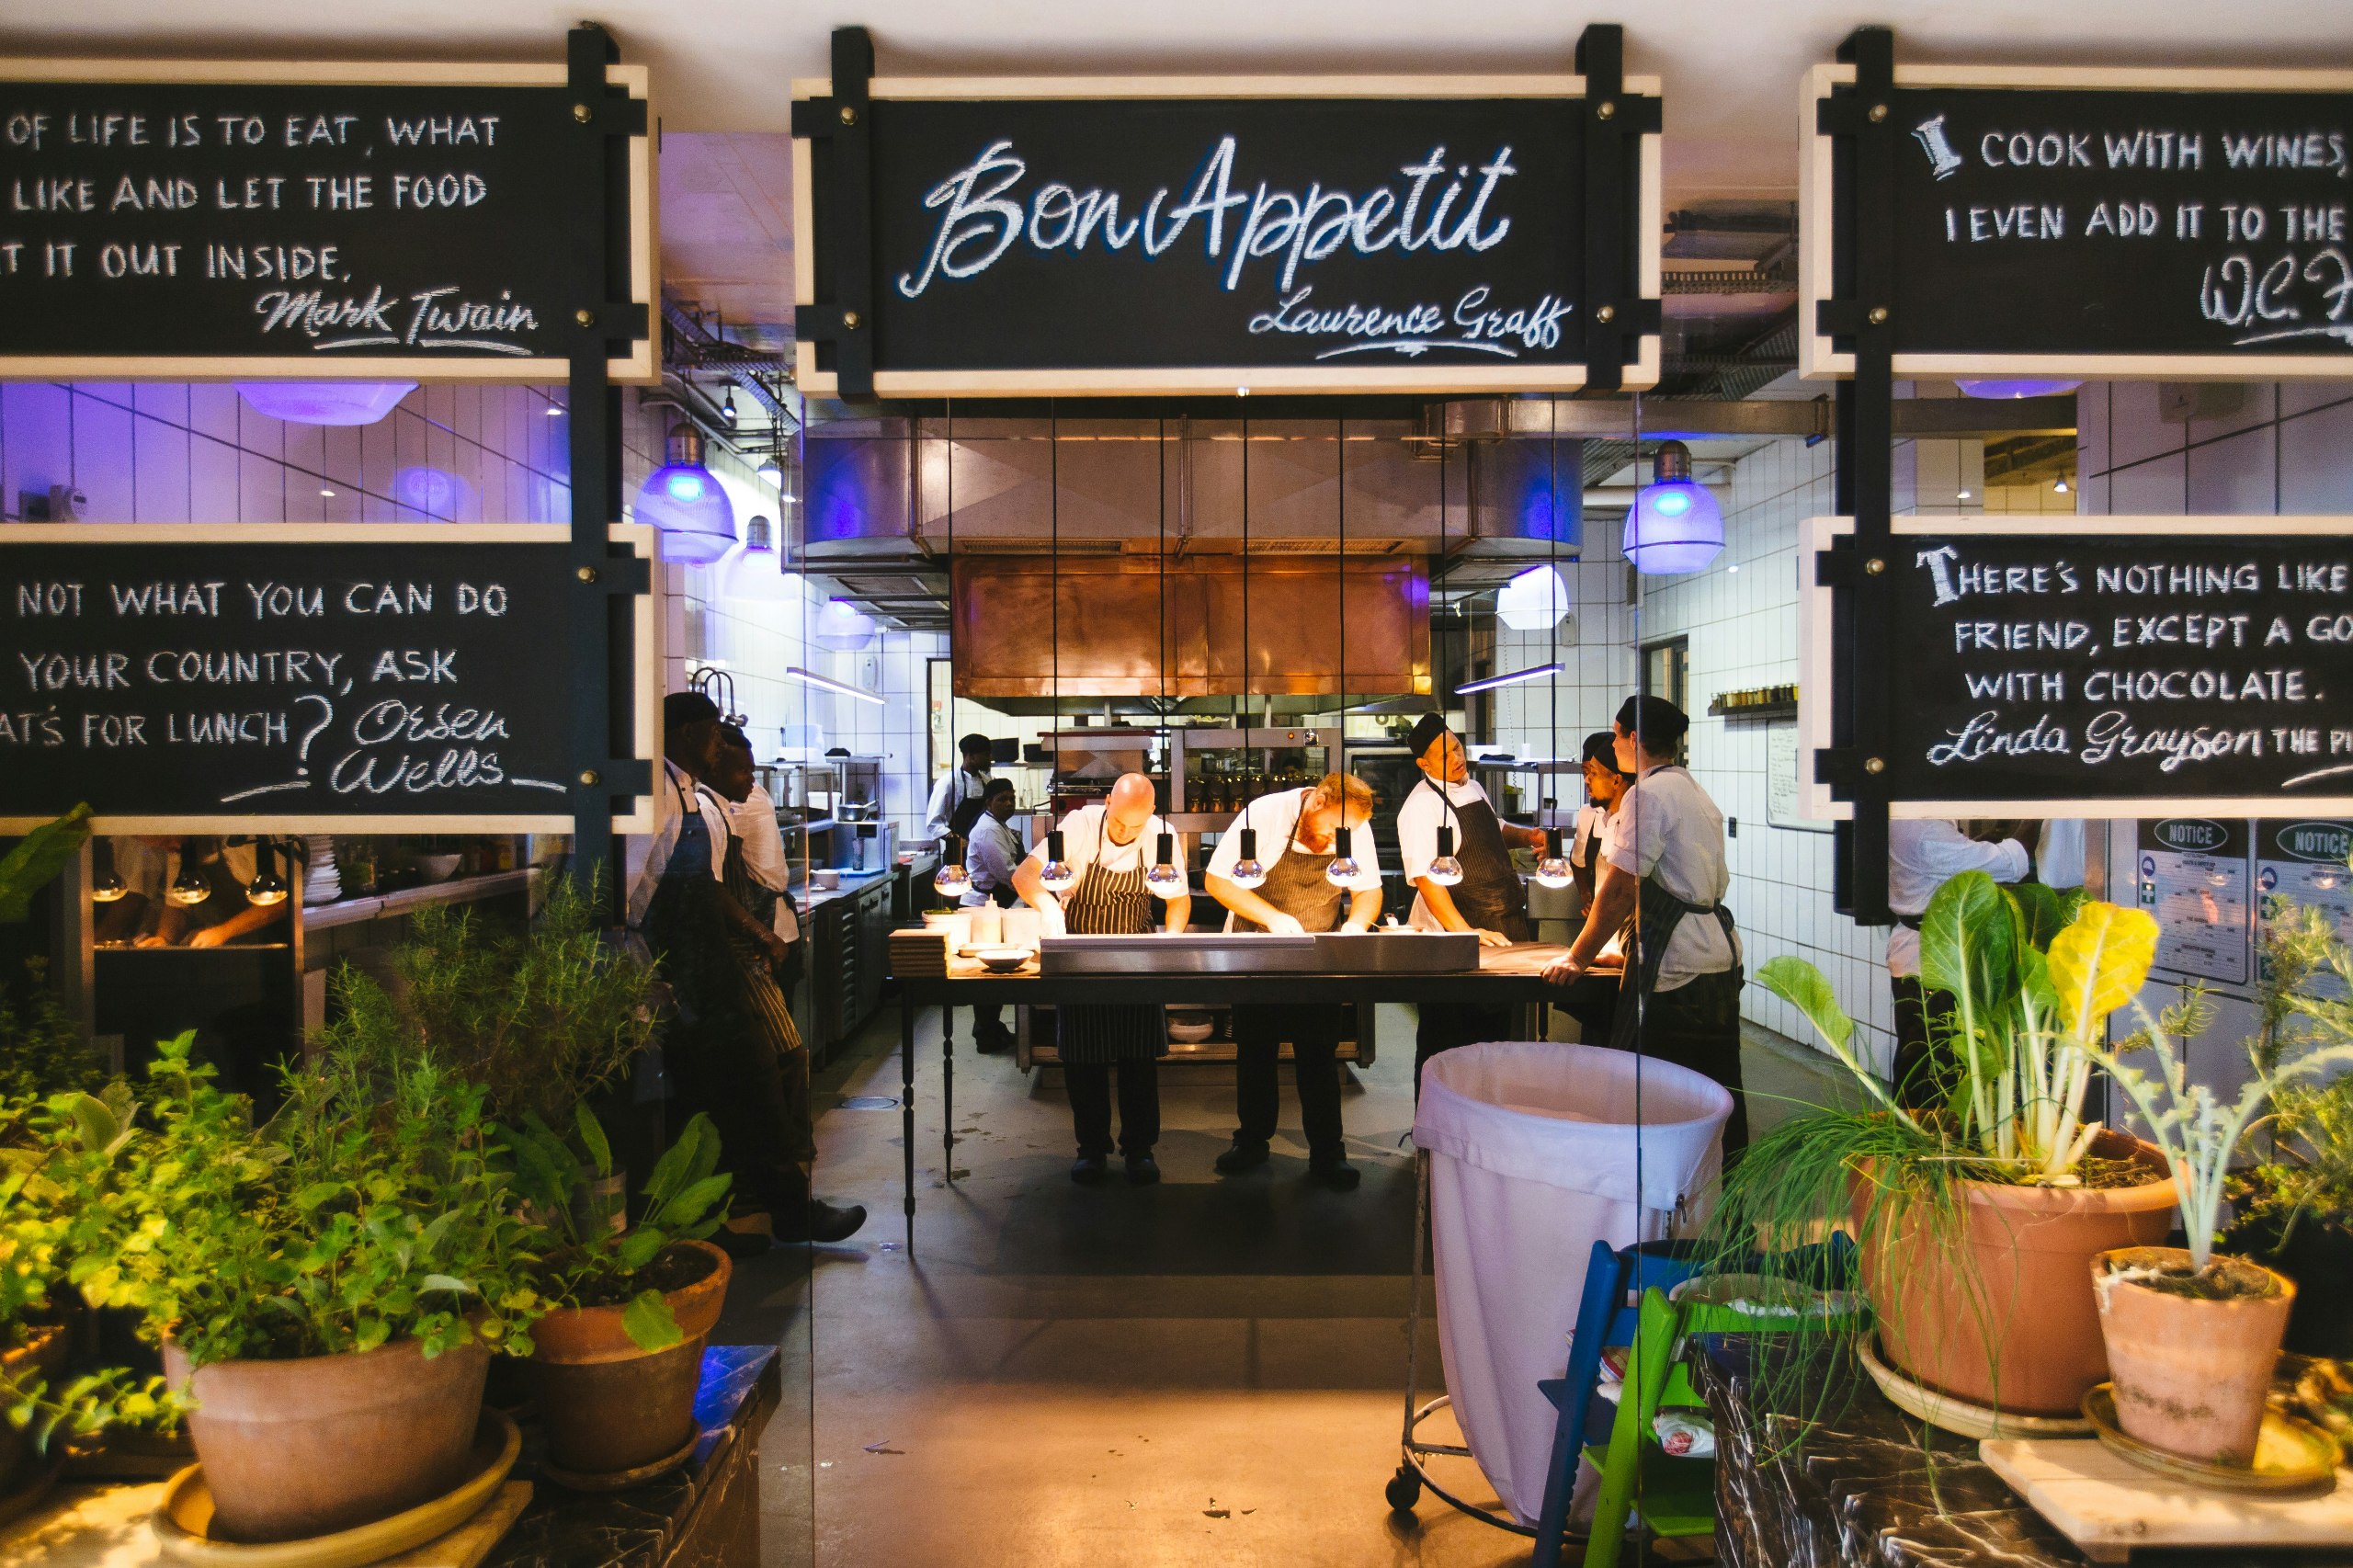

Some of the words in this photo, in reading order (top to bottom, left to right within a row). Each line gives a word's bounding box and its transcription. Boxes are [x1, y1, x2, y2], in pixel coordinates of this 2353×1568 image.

[8, 116, 45, 148] OF
[71, 116, 149, 145] LIFE
[170, 116, 199, 146] IS
[218, 117, 265, 144] TO
[287, 116, 370, 155] EAT,
[387, 117, 499, 145] WHAT
[1911, 115, 1962, 181] I
[1982, 132, 2090, 166] COOK
[2104, 131, 2201, 170] WITH
[2222, 134, 2346, 176] WINES,
[14, 180, 95, 210] LIKE
[112, 176, 198, 210] AND
[218, 177, 284, 209] LET
[306, 176, 372, 210] THE
[394, 174, 486, 209] FOOD
[898, 140, 1140, 298] Bon
[1143, 134, 1517, 291] Appetit
[1946, 209, 1956, 242] I
[1969, 205, 2064, 242] EVEN
[2086, 202, 2159, 236] ADD
[2177, 205, 2203, 239] IT
[2221, 206, 2265, 241] TO
[2279, 207, 2344, 240] THE
[0, 241, 25, 276] T
[46, 244, 75, 276] IT
[101, 244, 181, 277] OUT
[256, 285, 400, 337] Mark
[406, 287, 539, 346] Twain
[1248, 287, 1443, 335] Laurence
[1452, 286, 1573, 349] Graff
[1915, 545, 2078, 607] THERE'S
[2097, 563, 2259, 595] NOTHING
[2278, 564, 2347, 592] LIKE
[19, 584, 82, 615] NOT
[111, 583, 224, 617] WHAT
[247, 583, 324, 619] YOU
[345, 584, 432, 614] CAN
[458, 583, 507, 616] DO
[1955, 621, 2099, 656] FRIEND,
[2113, 614, 2249, 648] EXCEPT
[2264, 618, 2290, 646] A
[21, 653, 130, 688] YOUR
[147, 651, 353, 697] COUNTRY,
[372, 650, 457, 683] ASK
[1965, 672, 2063, 701] WITH
[2084, 670, 2324, 701] CHOCOLATE.
[84, 715, 147, 745] FOR
[169, 695, 336, 778] LUNCH?
[1927, 710, 2071, 766] Linda
[2080, 710, 2262, 772] Grayson
[2271, 728, 2319, 754] THE
[331, 747, 504, 793] Wells
[2168, 824, 2213, 845] NOTICE
[2294, 830, 2349, 854] NOTICE
